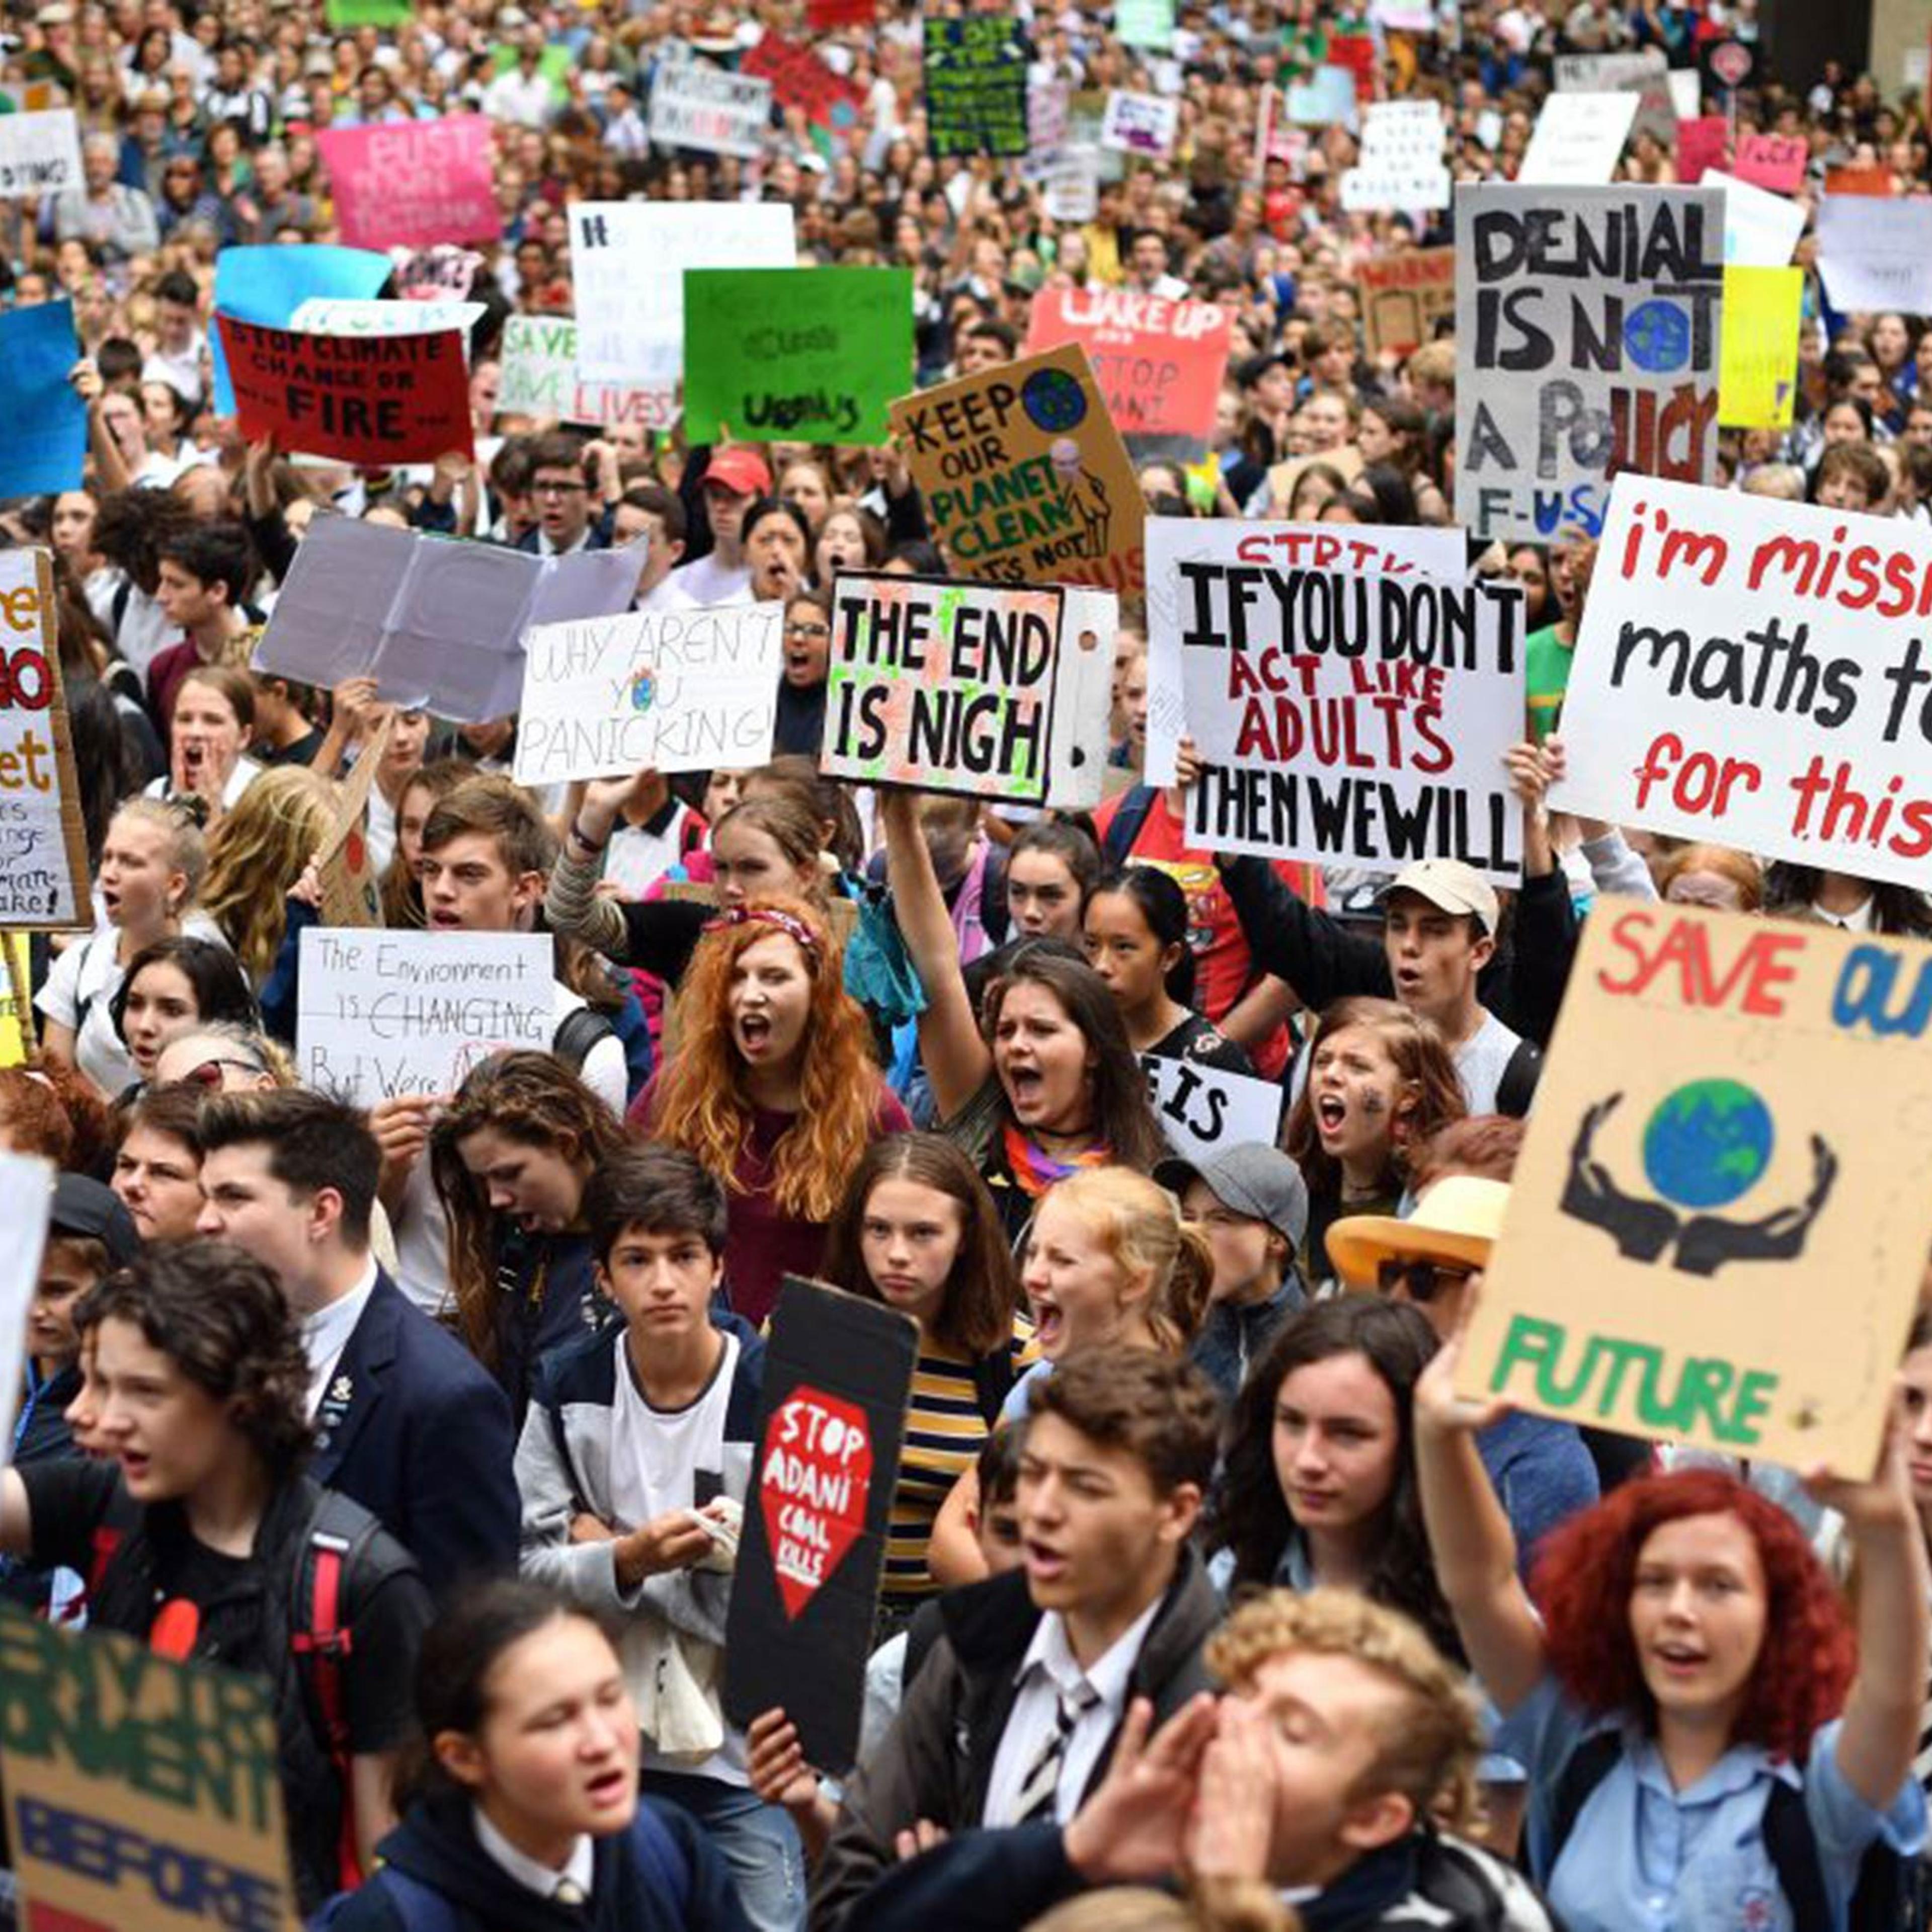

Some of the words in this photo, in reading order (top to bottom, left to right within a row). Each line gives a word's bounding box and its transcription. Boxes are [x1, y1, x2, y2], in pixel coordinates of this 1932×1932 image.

[1475, 202, 1724, 283] DENIAL
[231, 321, 301, 354] STOP
[312, 333, 442, 362] CLIMATE
[504, 320, 577, 359] SAVE
[1060, 289, 1169, 334] WAKE
[1171, 303, 1225, 341] UP
[1475, 287, 1555, 371] IS
[1572, 284, 1722, 372] NOT
[286, 385, 407, 441] FIRE
[574, 381, 671, 424] LIVES
[906, 383, 1016, 454] KEEP
[1465, 400, 1517, 471] A
[931, 454, 1060, 526] PLANET
[941, 436, 1010, 479] OUR
[950, 494, 1075, 557] CLEAN
[1479, 484, 1611, 538] F-US
[1621, 502, 1728, 586] i'm
[1031, 532, 1094, 570] NOT
[531, 624, 613, 682] WHY
[840, 598, 932, 669] THE
[952, 607, 1051, 686] END
[1179, 562, 1263, 650] IF
[1264, 568, 1370, 657] YOU
[1381, 578, 1523, 674] DON'T
[1229, 647, 1321, 700] ACT
[1350, 657, 1446, 710] LIKE
[1611, 618, 1863, 729] maths
[835, 682, 889, 760] IS
[908, 689, 1042, 780] NIGH
[1235, 696, 1454, 774] ADULTS
[1194, 763, 1297, 848] THEN
[1308, 775, 1378, 858] WE
[1380, 782, 1520, 873] WILL
[1633, 733, 1761, 818] for
[1790, 755, 1932, 858] this
[318, 938, 361, 971] The
[1597, 912, 1806, 1018] SAVE
[367, 992, 544, 1041] CHANGING
[1162, 1065, 1228, 1143] IS
[1490, 1313, 1780, 1444] FUTURE
[780, 1400, 865, 1466] STOP
[776, 1535, 824, 1576] KILLS
[778, 1504, 831, 1551] COAL
[15, 1795, 288, 1932] BEFORE
